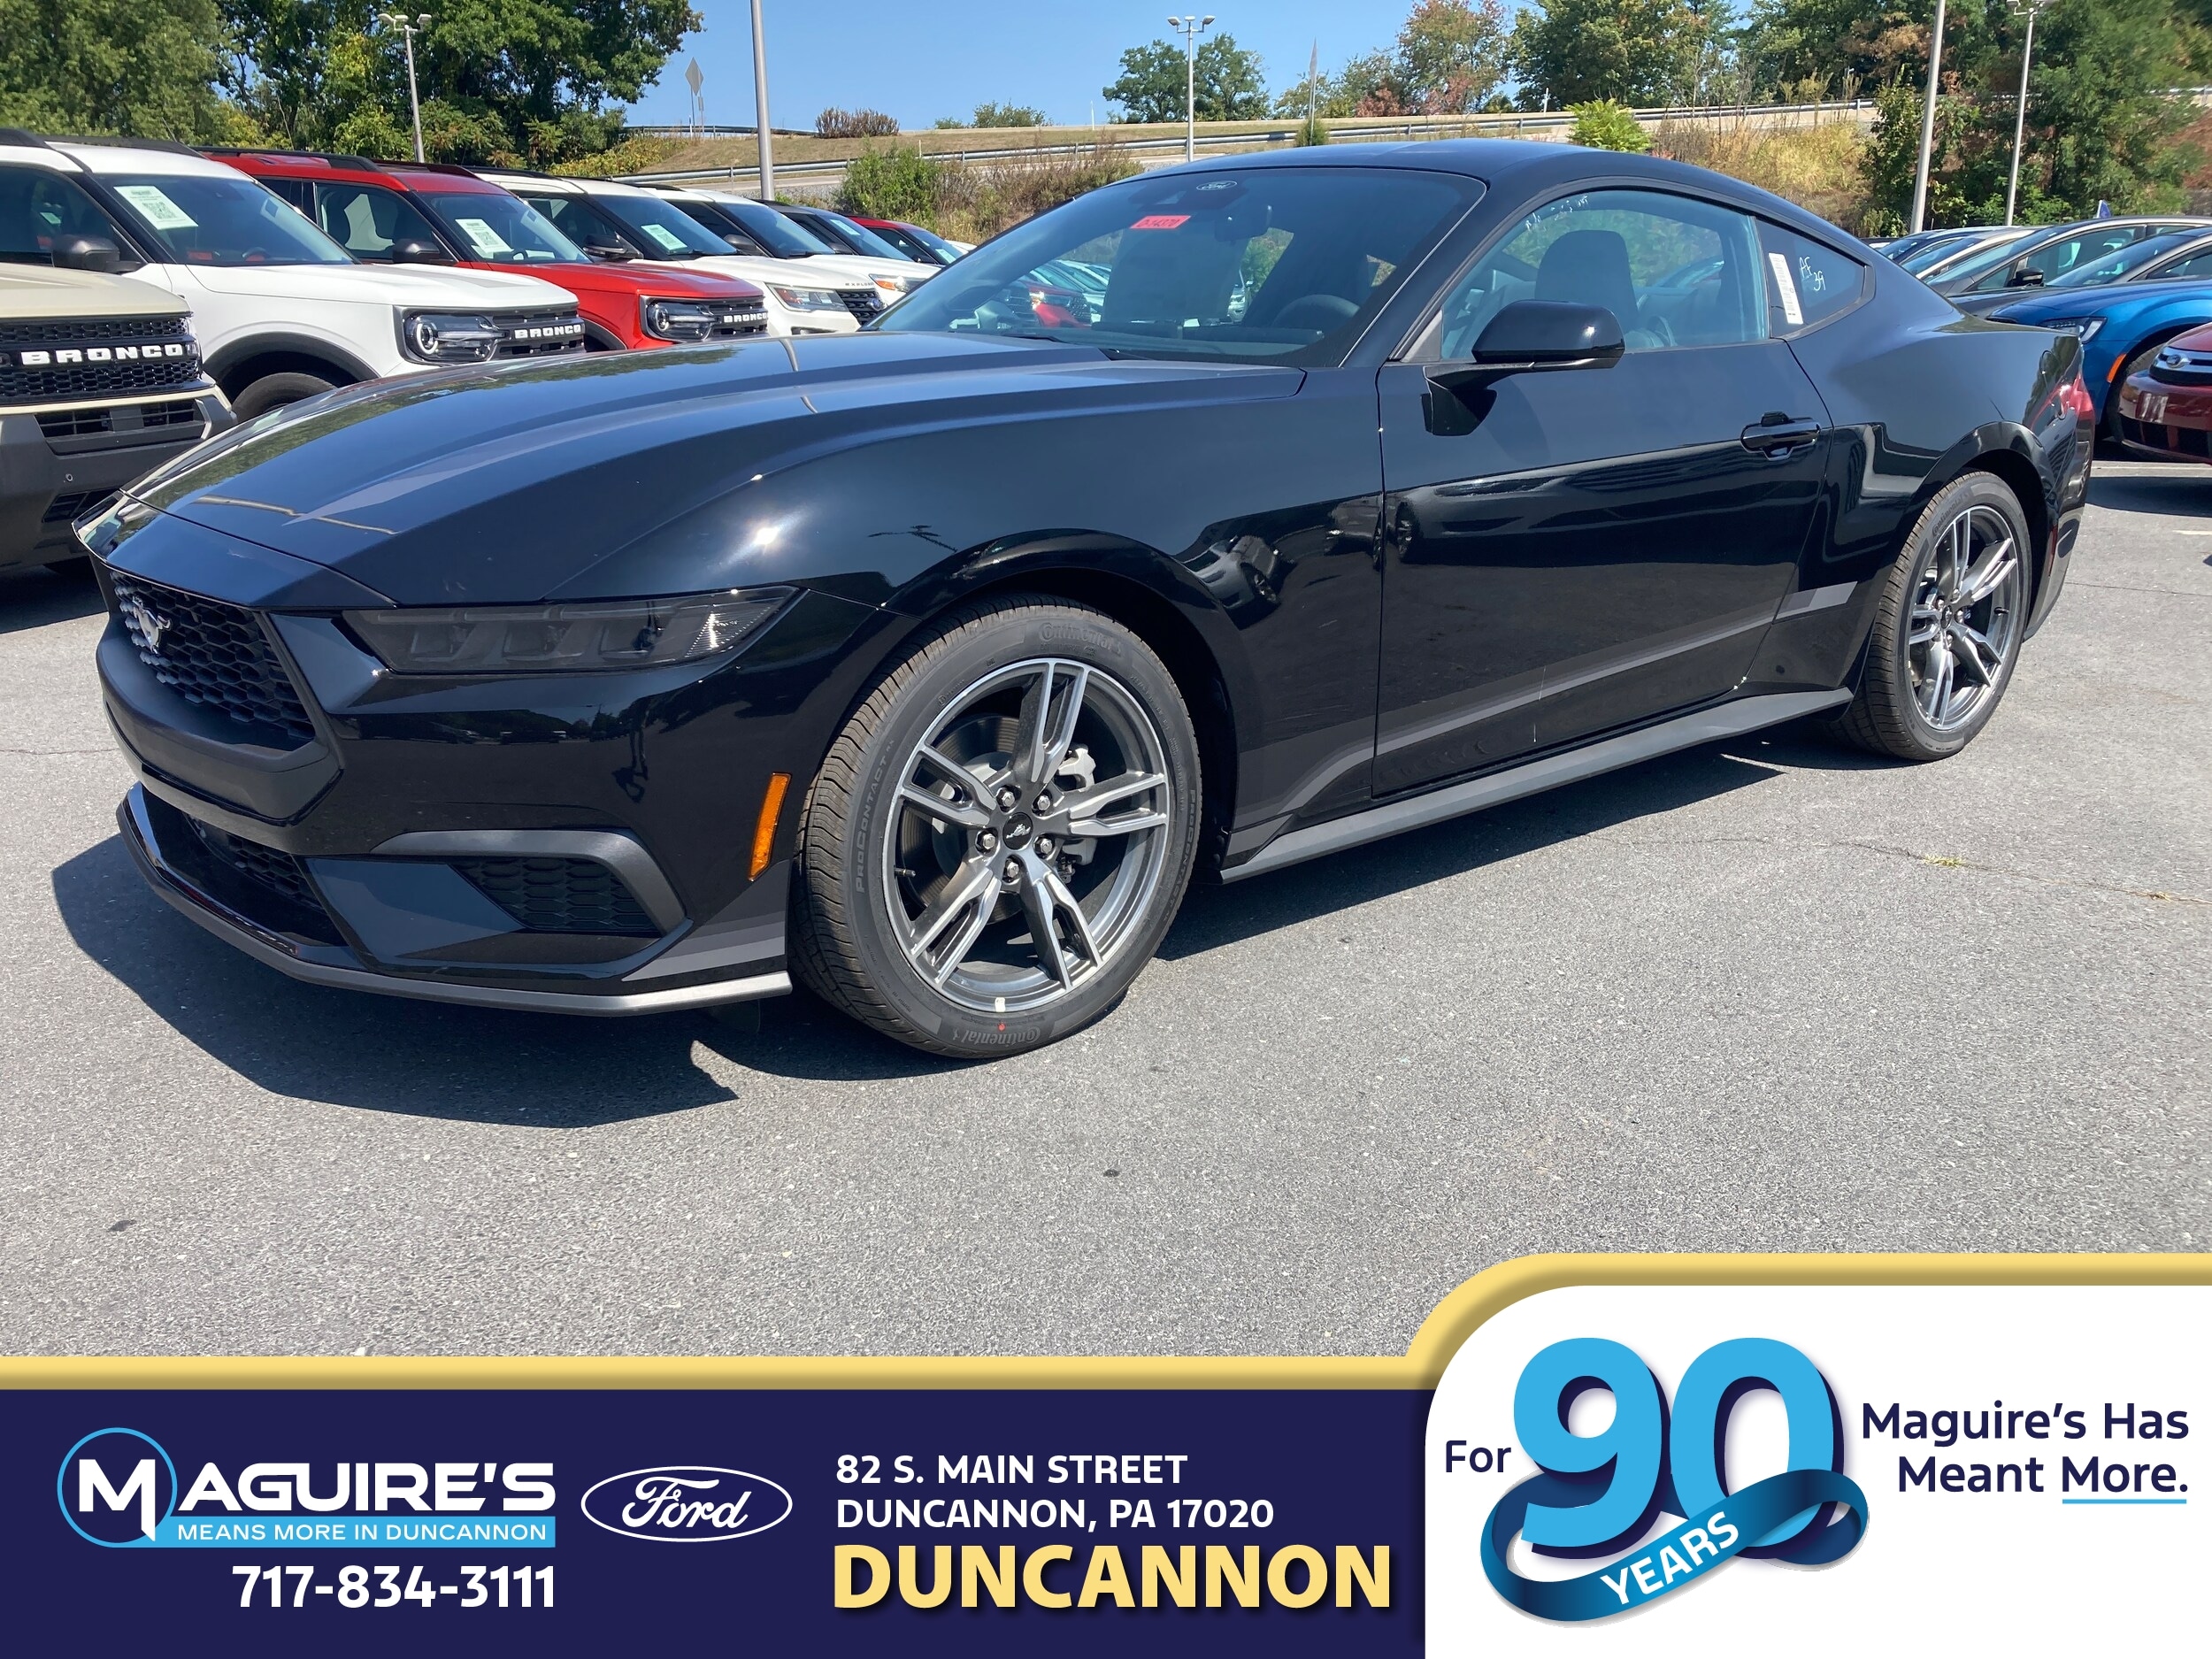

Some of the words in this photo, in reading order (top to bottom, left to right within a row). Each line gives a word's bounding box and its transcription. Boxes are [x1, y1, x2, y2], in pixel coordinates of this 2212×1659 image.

[724, 311, 767, 323] BRONCO
[514, 324, 581, 339] BRONCO
[20, 343, 183, 365] BRONCO
[961, 1026, 1041, 1045] Continental
